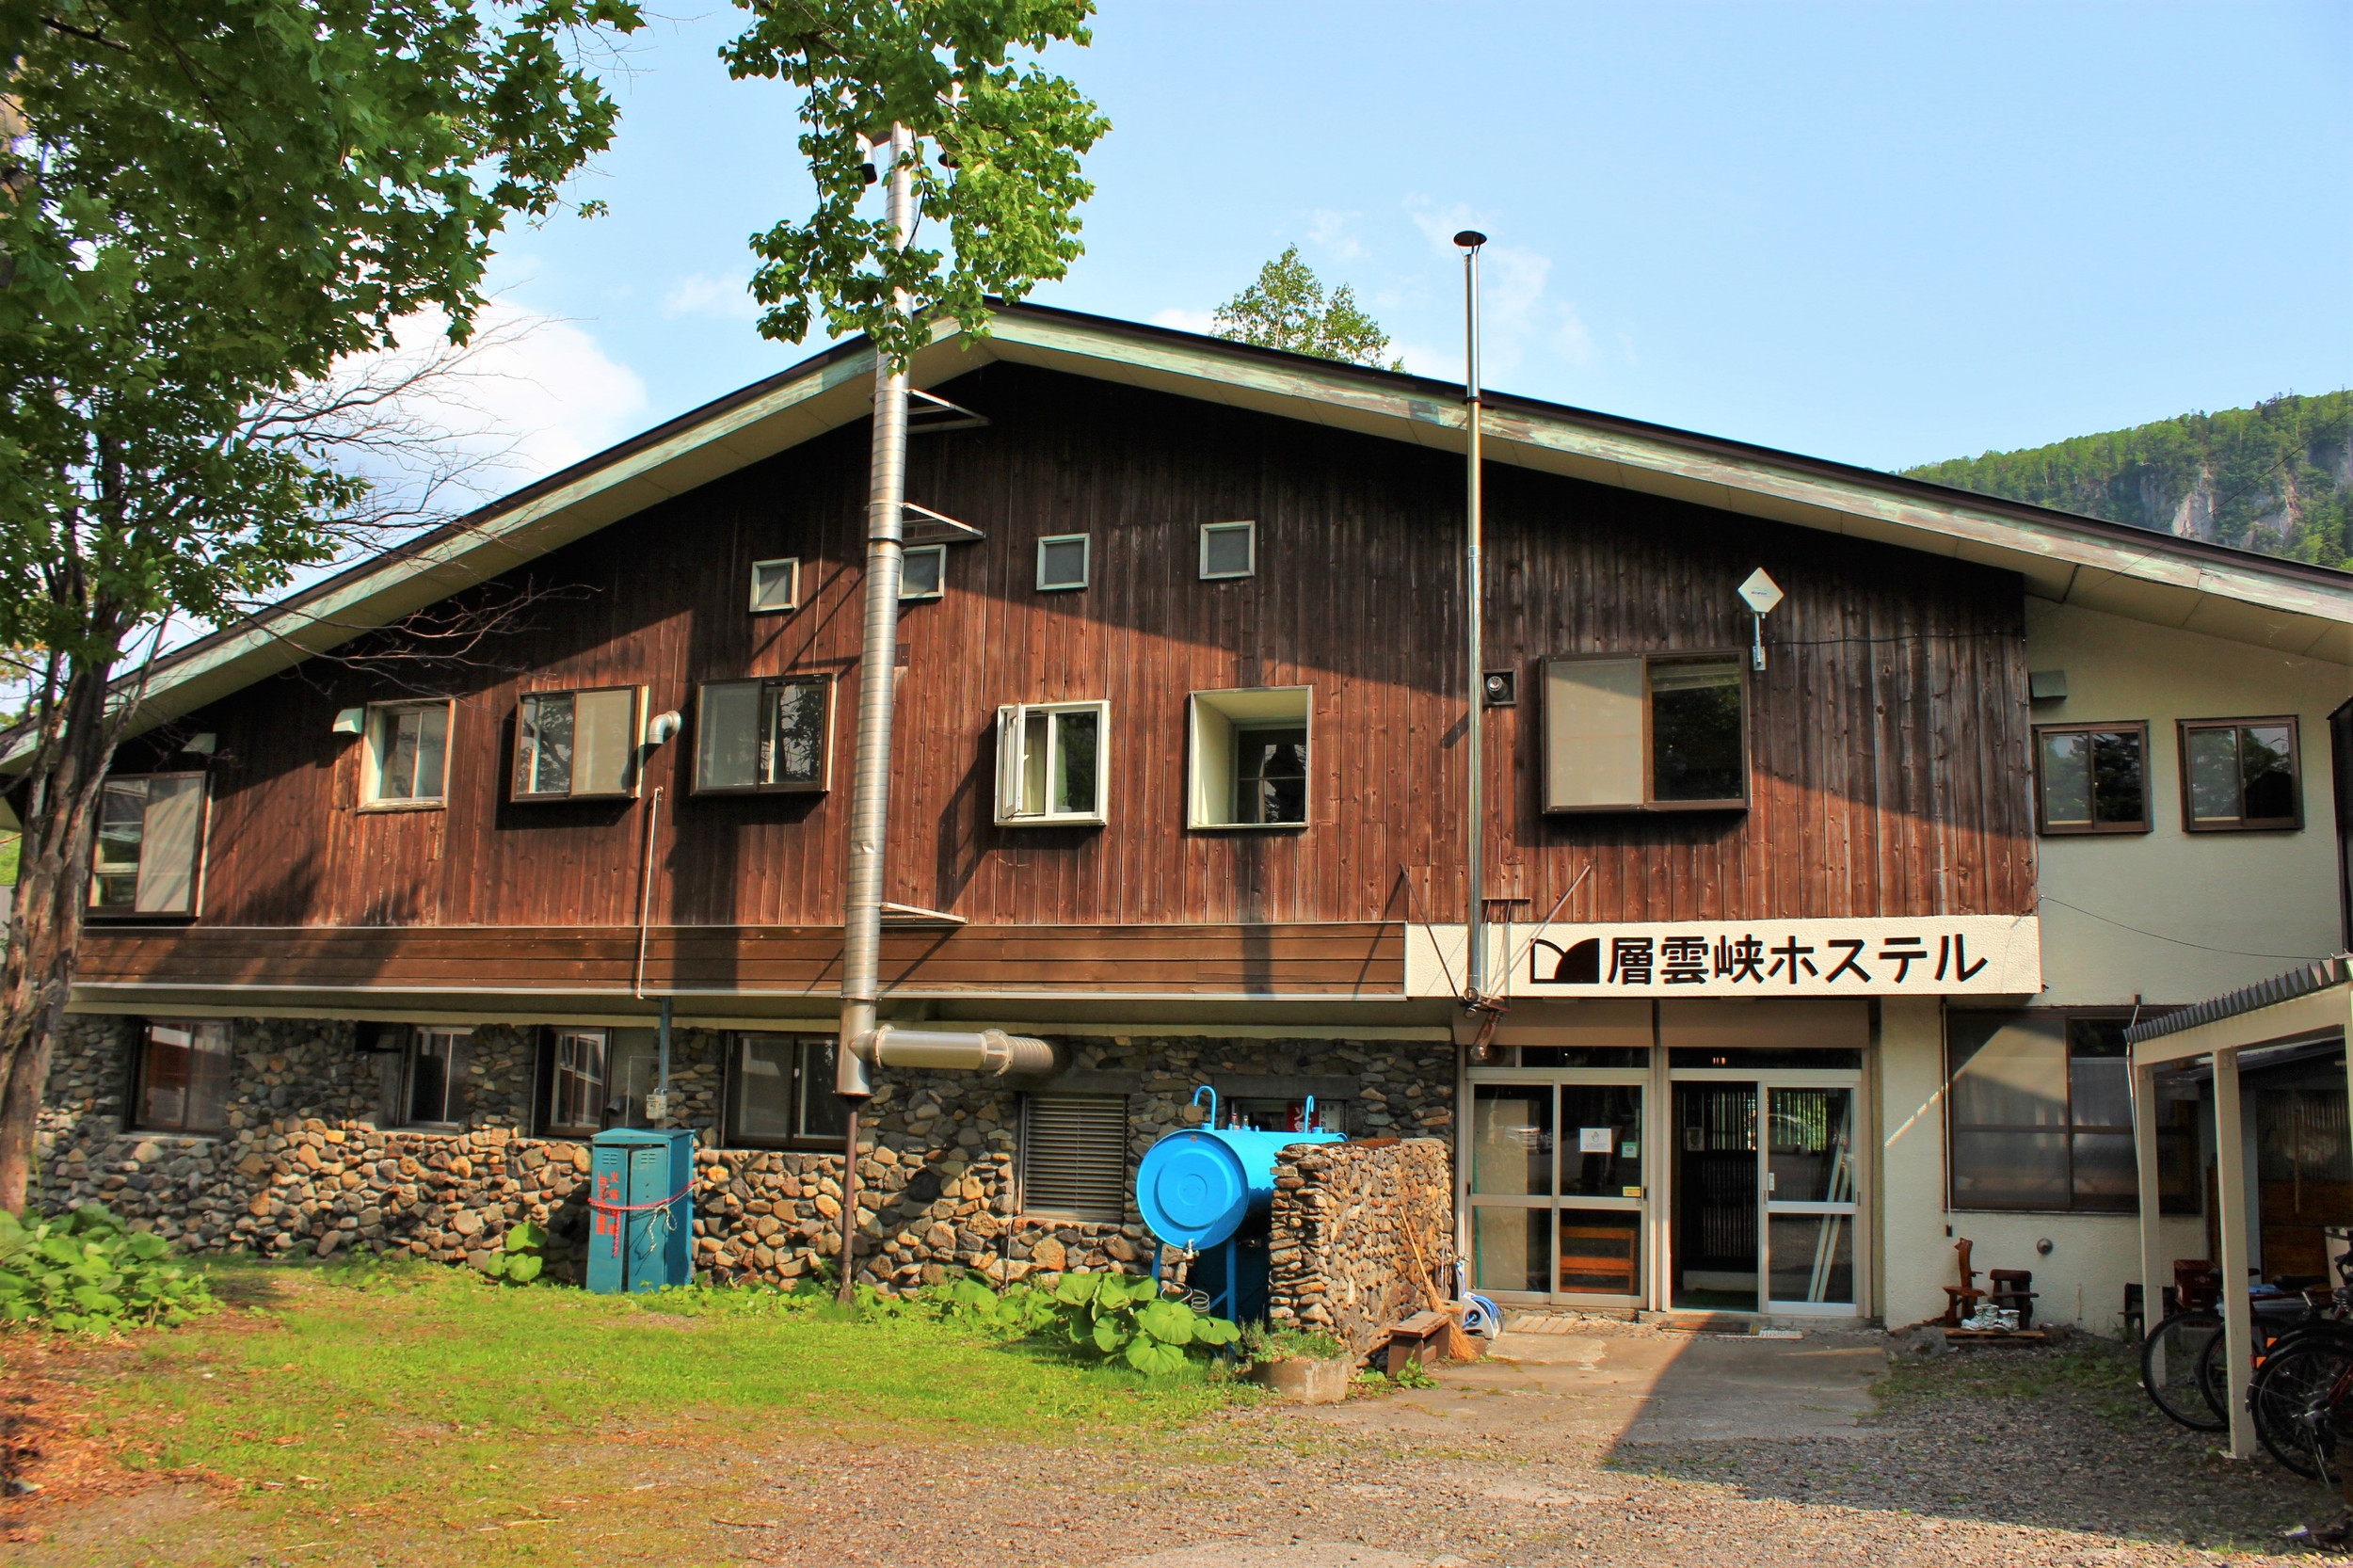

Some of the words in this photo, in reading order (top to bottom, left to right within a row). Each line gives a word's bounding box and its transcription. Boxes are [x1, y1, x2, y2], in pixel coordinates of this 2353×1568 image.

[1608, 933, 1988, 984] 層雲峡ホステル
